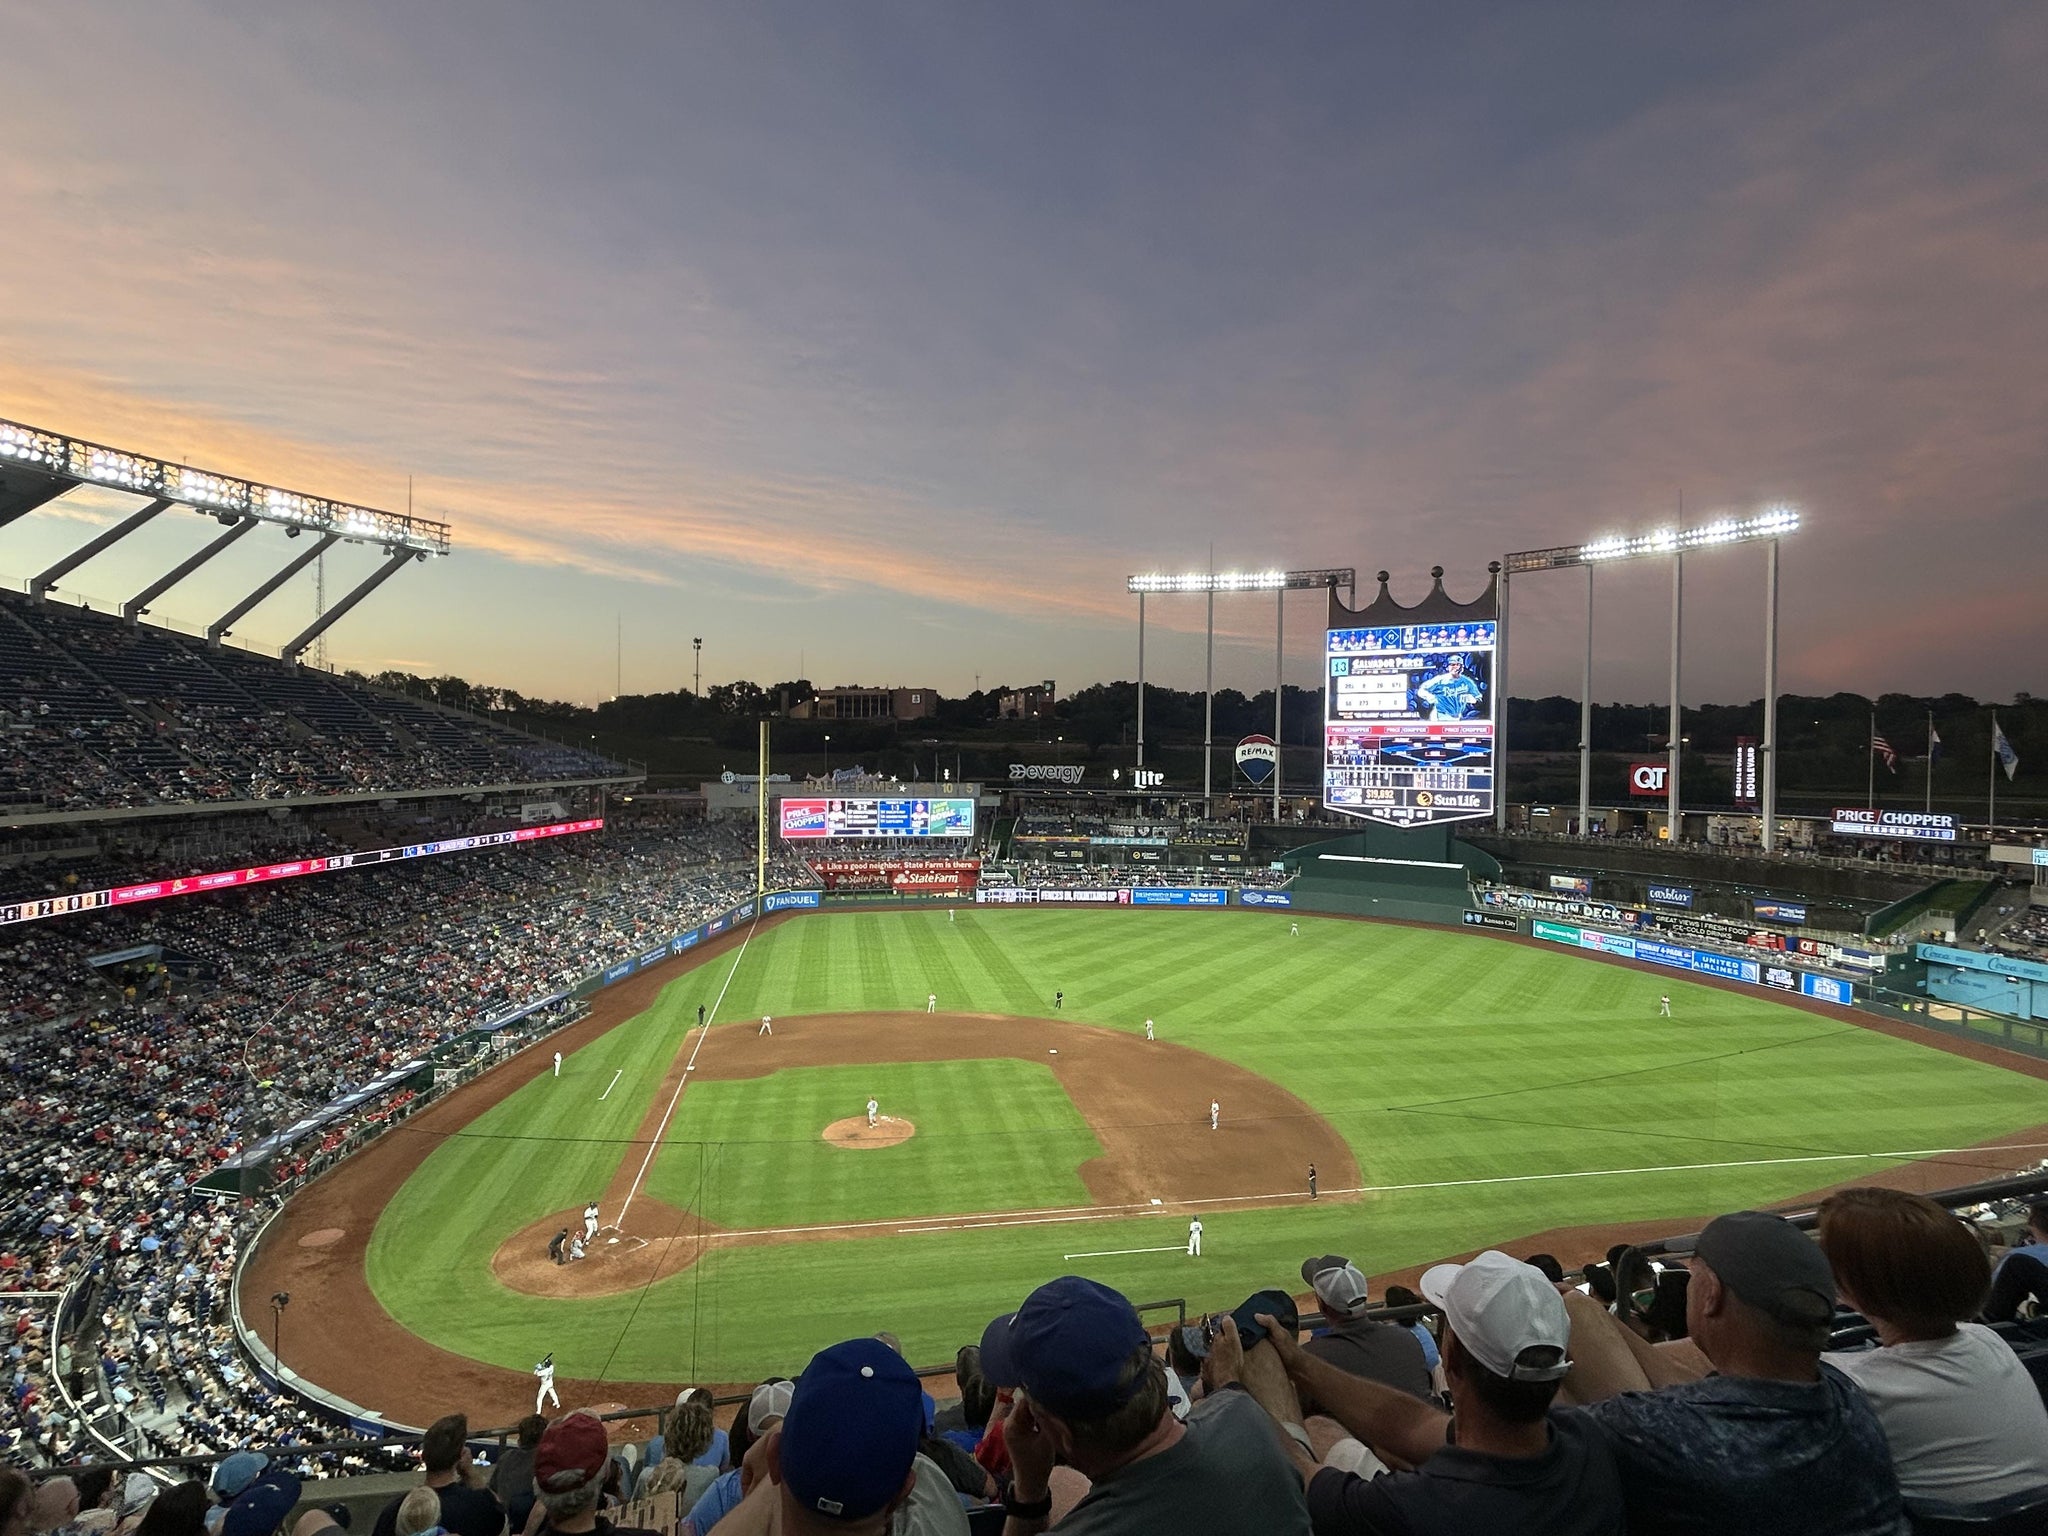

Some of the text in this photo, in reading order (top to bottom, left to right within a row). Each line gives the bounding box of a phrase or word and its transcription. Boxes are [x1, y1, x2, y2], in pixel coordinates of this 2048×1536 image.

[1334, 661, 1347, 672] 13
[1241, 748, 1274, 757] RE/MAX
[1027, 764, 1085, 784] evergy
[1634, 766, 1667, 790] QT
[1746, 747, 1756, 797] BOULEVARD
[1133, 770, 1165, 789] Lite
[737, 783, 751, 793] 42
[942, 784, 953, 793] 10
[966, 784, 974, 793] 5
[1435, 795, 1480, 807] Sun Life
[786, 808, 810, 819] PRICE
[1836, 810, 1953, 828] PRICE CHOPPER
[785, 815, 825, 829] CHOPPER
[850, 862, 867, 871] good
[904, 861, 923, 869] State
[28, 906, 34, 916] B
[42, 902, 50, 915] 2
[58, 901, 64, 910] S
[71, 897, 79, 909] 0
[100, 893, 106, 905] 1
[776, 896, 815, 906] FANDUEL
[1583, 906, 1622, 920] DECK
[1484, 917, 1516, 928] Kansas City
[1655, 915, 1749, 936] GREAT VIEWS FRESH FOOD
[1673, 925, 1733, 939] ICE-COLD DRINKS
[1603, 937, 1632, 948] CHOPPER
[1800, 941, 1814, 952] QT
[1693, 961, 1739, 976] AIRLINES
[1702, 955, 1739, 969] UNITED
